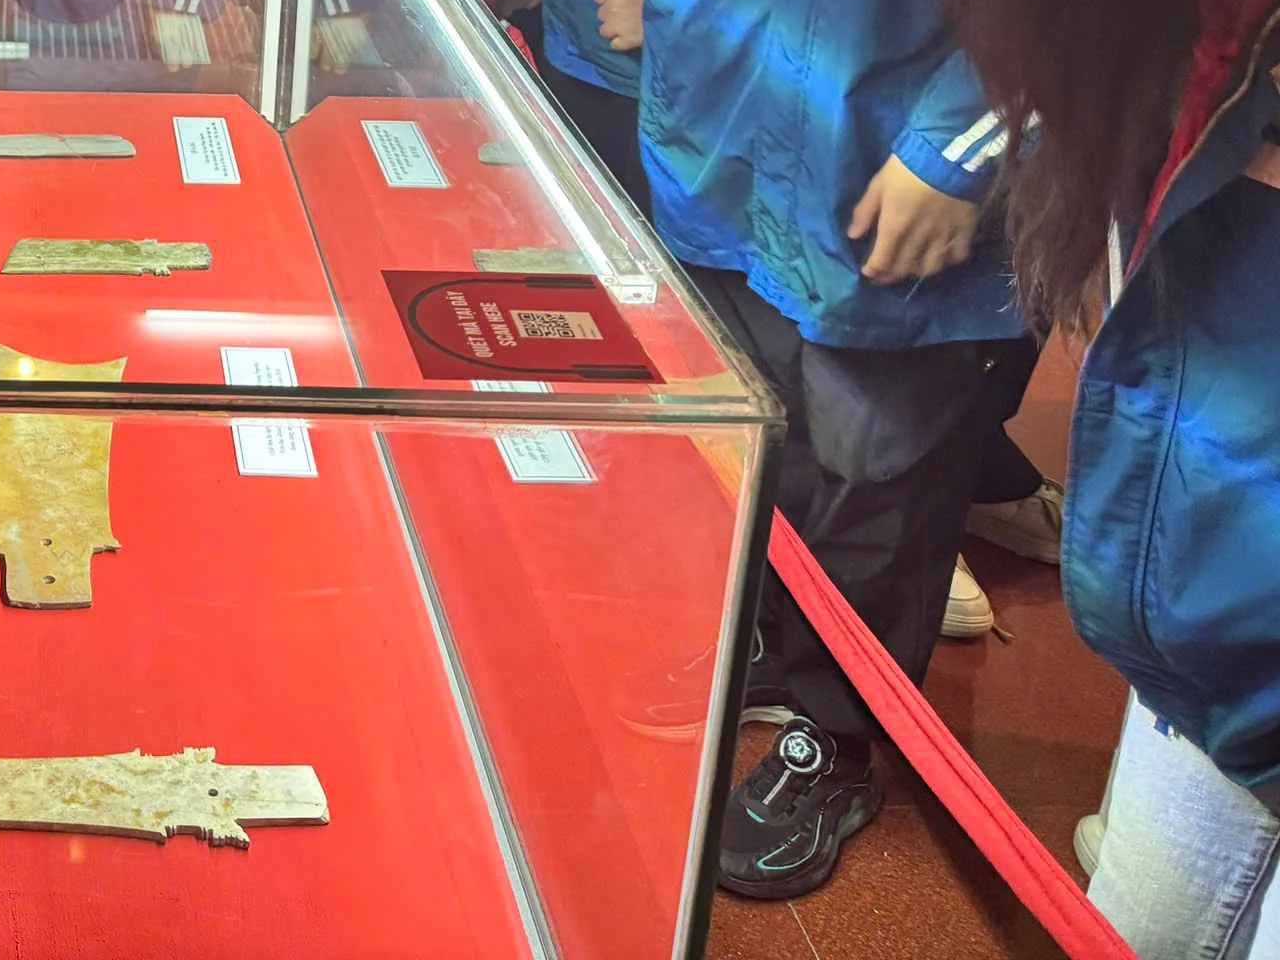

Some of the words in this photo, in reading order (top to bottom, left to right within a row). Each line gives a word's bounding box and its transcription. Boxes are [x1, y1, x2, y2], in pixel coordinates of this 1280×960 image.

[454, 307, 477, 320] TẠI
[480, 302, 505, 322] HERE
[490, 324, 518, 347] SCAN
[466, 336, 495, 358] QUÉT
